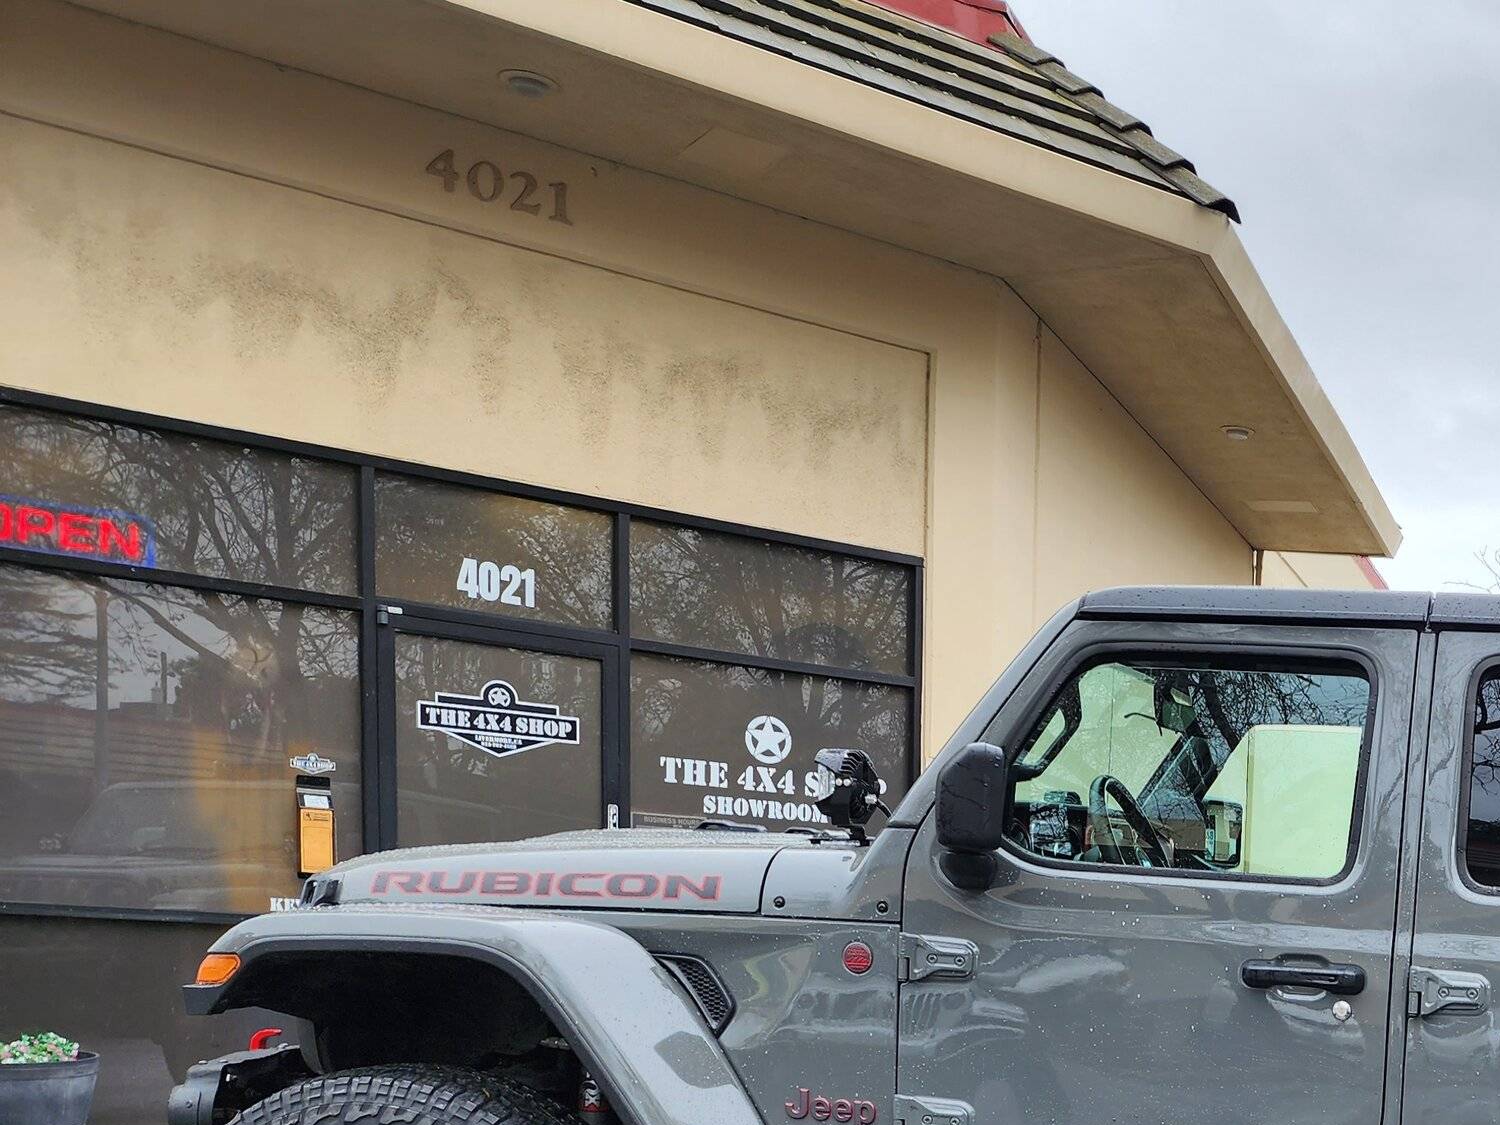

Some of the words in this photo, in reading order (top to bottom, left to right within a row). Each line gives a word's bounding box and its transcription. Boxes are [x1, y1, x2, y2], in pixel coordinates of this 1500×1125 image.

[425, 149, 574, 226] 4021
[456, 557, 535, 608] 4021
[425, 707, 471, 728] THE
[473, 712, 513, 733] 4X4
[515, 716, 573, 738] SHOP
[659, 756, 728, 789] THE
[737, 765, 796, 795] 4X4
[703, 794, 829, 824] SHOWROOM
[371, 870, 722, 900] RUBICON
